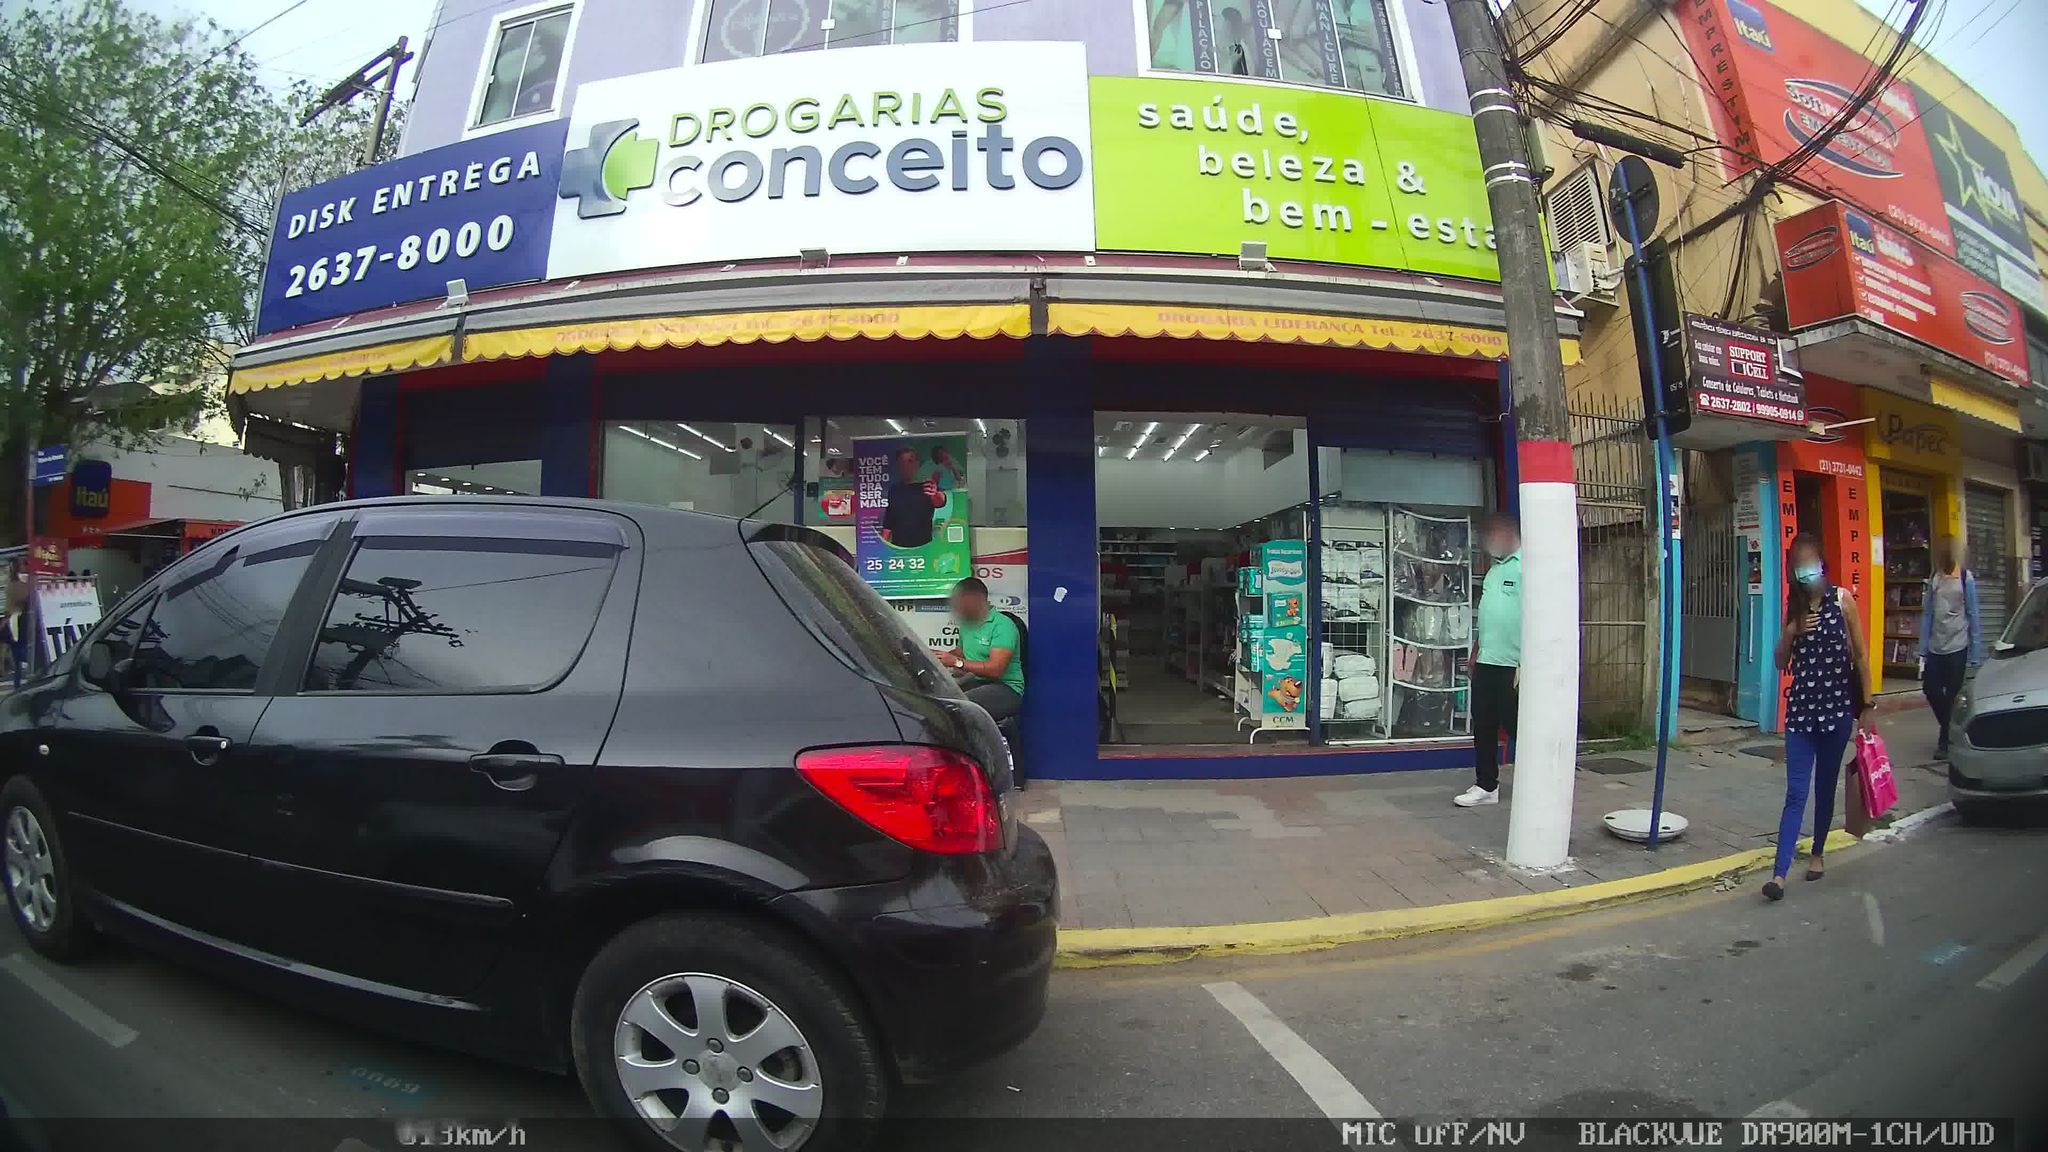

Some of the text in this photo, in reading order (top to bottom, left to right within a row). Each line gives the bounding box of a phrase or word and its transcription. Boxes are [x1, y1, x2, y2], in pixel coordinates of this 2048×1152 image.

[668, 87, 1009, 148] DROGARIAS
[1138, 94, 1310, 144] saúde,
[661, 123, 1084, 206] conceito
[1198, 145, 1366, 186] beleza
[1396, 159, 1428, 195] &
[287, 197, 358, 240] DISK
[1242, 187, 1353, 232] bem
[1406, 212, 1498, 250] esta
[1849, 230, 1876, 255] Itaú
[285, 214, 516, 298] 2637-8000
[1728, 345, 1767, 363] SUPPORT
[1702, 375, 1725, 392] Conserto
[1710, 395, 1752, 414] 2637-2802
[858, 453, 889, 466] VOCÊ
[859, 465, 882, 475] TEM
[859, 473, 890, 483] TUDO
[859, 482, 883, 492] PRA
[859, 490, 882, 500] SER
[76, 486, 109, 509] Itaú
[859, 498, 889, 509] MAIS
[866, 557, 926, 571] 25 24 32
[976, 567, 1004, 580] OS
[941, 626, 960, 639] CA
[1272, 715, 1294, 725] CCM
